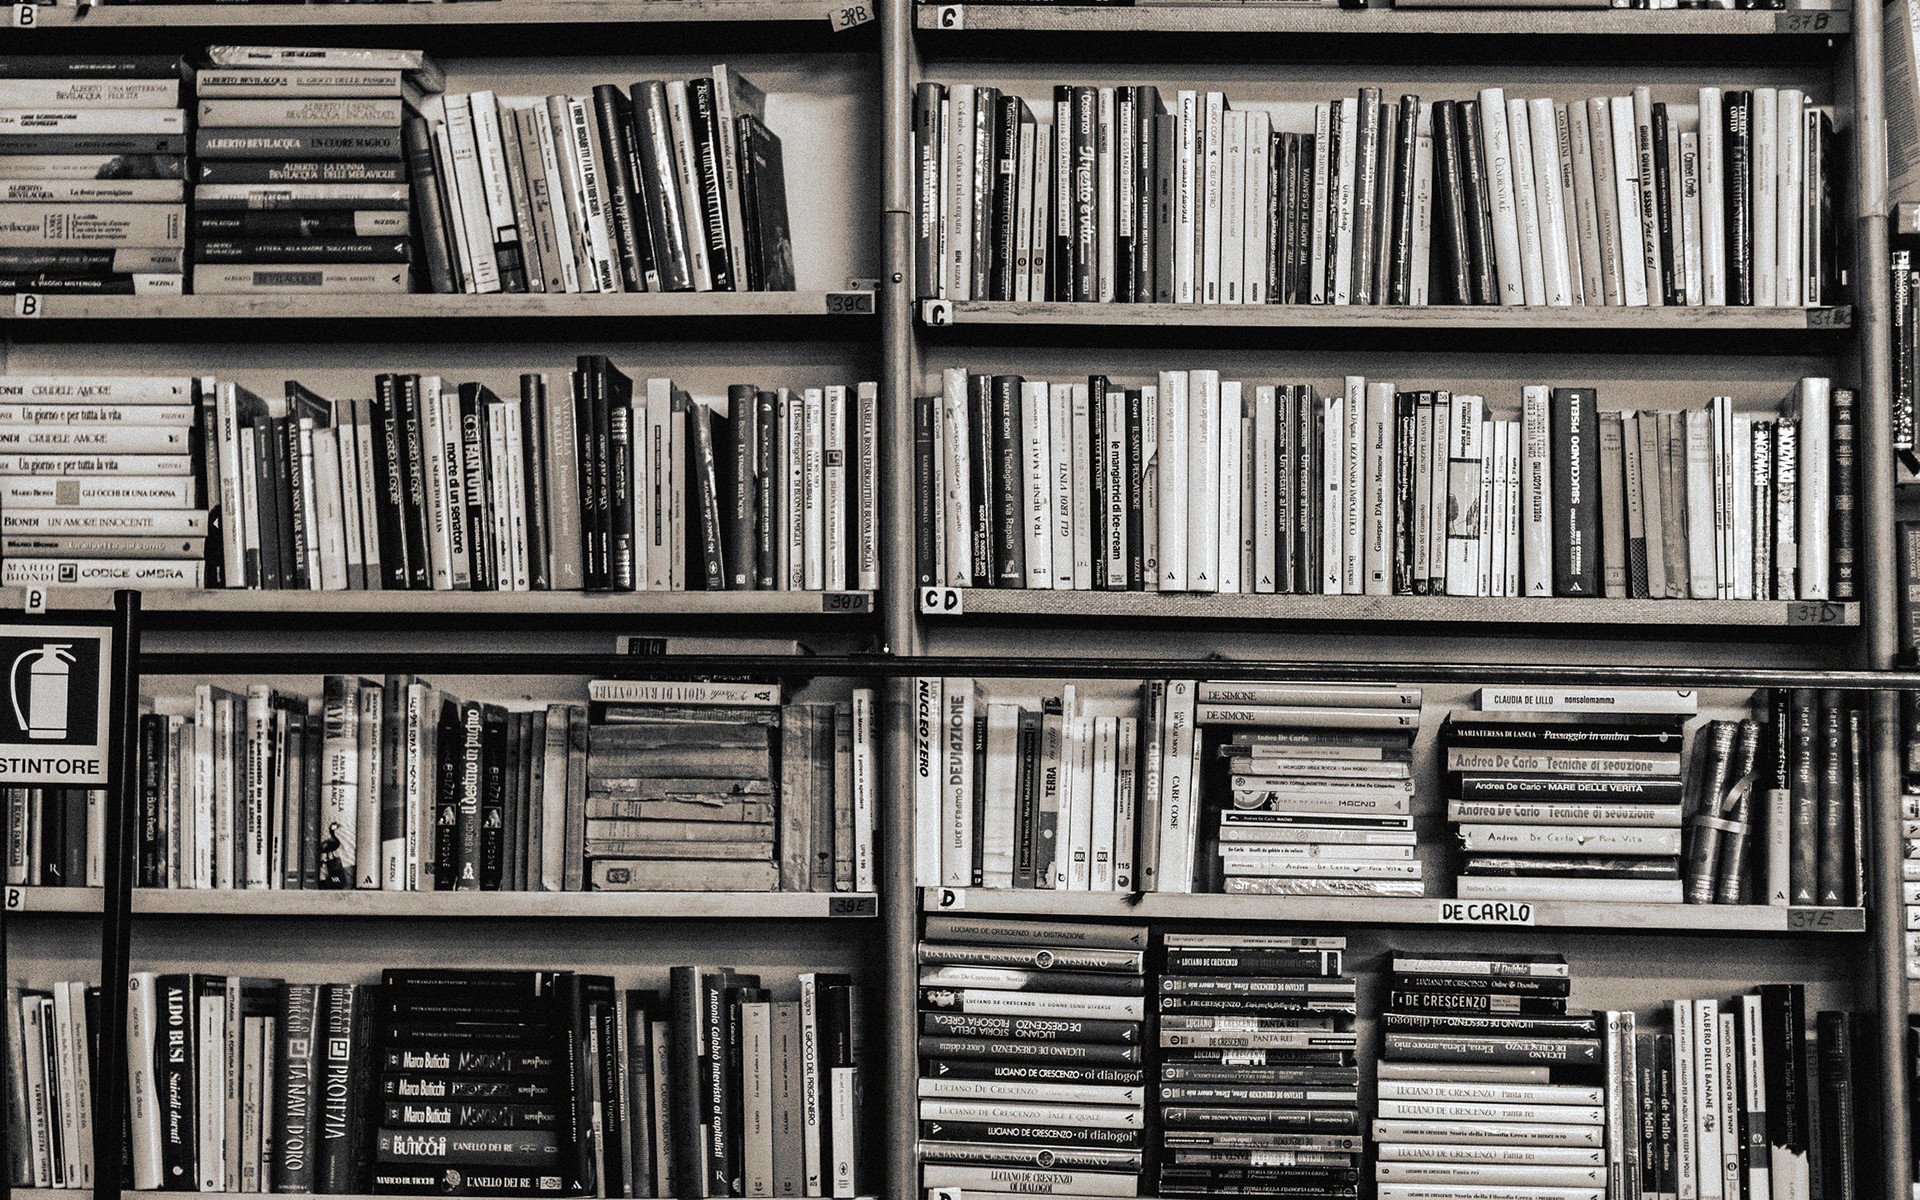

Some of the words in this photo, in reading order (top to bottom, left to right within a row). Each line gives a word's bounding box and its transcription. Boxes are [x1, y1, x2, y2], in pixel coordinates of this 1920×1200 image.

[20, 8, 34, 26] B
[956, 101, 966, 135] Colombo
[1730, 106, 1738, 132] COVITO
[1738, 106, 1746, 136] CARMEN
[206, 140, 245, 148] ALBERTO
[248, 140, 300, 150] BEVILACQUA
[1558, 110, 1568, 158] COSTANTINI
[1563, 163, 1571, 188] Veleno
[956, 144, 966, 182] Confucio
[1684, 152, 1696, 177] Carmen
[324, 171, 346, 179] DELLE
[348, 171, 396, 179] MERAVIGLIE
[956, 184, 965, 196] nel
[1302, 168, 1310, 209] CASANOVA
[1685, 178, 1696, 198] Covito
[954, 197, 964, 235] computer
[1302, 212, 1308, 220] DI
[599, 259, 613, 290] BOMPIANI
[22, 296, 36, 314] B
[932, 305, 945, 325] C
[1002, 382, 1010, 416] RAFFAELE
[22, 408, 33, 420] Un
[35, 411, 58, 424] giorno
[67, 412, 80, 424] per
[81, 409, 98, 420] tutta
[100, 409, 107, 420] la
[108, 409, 121, 420] vita
[1571, 394, 1579, 433] PISELLI
[1003, 418, 1011, 440] CROVI
[1111, 441, 1121, 450] le
[446, 443, 457, 476] morte
[1002, 448, 1013, 491] L'indagine
[1571, 436, 1580, 504] SBUCCIANDO
[449, 479, 459, 488] di
[1060, 462, 1068, 490] VINTI
[1110, 452, 1121, 500] mangiatrici
[450, 490, 459, 503] un
[1060, 495, 1068, 516] EROI
[1112, 502, 1121, 513] di
[1005, 504, 1013, 515] via
[450, 506, 463, 554] senatore
[1003, 518, 1014, 550] Rapallo
[1061, 520, 1069, 537] GLI
[1112, 514, 1121, 560] ice-cream
[82, 569, 129, 578] CODICE
[136, 569, 183, 578] OMBRA
[30, 590, 41, 608] B
[830, 595, 863, 609] 38D
[594, 686, 658, 700] RACCONTARE
[661, 687, 673, 700] DI
[677, 687, 706, 700] GIOIA
[1208, 691, 1222, 699] DE
[1223, 692, 1257, 701] SIMONE
[1494, 695, 1523, 704] CLAUDIA
[1524, 696, 1533, 705] DE
[1536, 696, 1553, 705] LILLO
[1564, 696, 1615, 704] nonsolomamma
[919, 680, 929, 737] NUCLEO
[1206, 711, 1221, 720] DE
[1221, 712, 1255, 721] SIMONE
[464, 709, 482, 747] pugno
[1830, 737, 1837, 748] De
[464, 749, 478, 760] in
[919, 740, 929, 777] ZERO
[1148, 741, 1159, 771] CARE
[1828, 752, 1837, 784] Filippi
[461, 762, 478, 804] destino
[1045, 767, 1056, 797] TERRA
[1147, 772, 1158, 801] COSE
[1171, 776, 1180, 802] CARE
[1548, 783, 1576, 791] MARE
[1610, 784, 1643, 792] VERITÀ
[461, 805, 476, 814] il
[1170, 805, 1179, 830] COSE
[1829, 800, 1838, 826] Amici
[1118, 862, 1130, 870] 115
[6, 890, 21, 908] B
[940, 890, 956, 907] D
[1443, 904, 1463, 920] DE
[1468, 904, 1530, 922] CARLO
[950, 926, 979, 934] LUCIANO
[991, 928, 1030, 936] CRESCENZO
[1033, 930, 1044, 938] LA
[1046, 931, 1085, 940] DISTRAZIONE
[168, 987, 183, 1026] ALDO
[710, 989, 720, 1024] Antonio
[1406, 995, 1420, 1005] DE
[1423, 996, 1487, 1008] CRESCENZO
[1703, 1006, 1712, 1046] L'ALBERO
[169, 1030, 184, 1063] BUSI
[711, 1026, 722, 1060] Calabrò
[403, 1052, 423, 1068] Marco
[424, 1051, 450, 1068] Buticchi
[1704, 1048, 1712, 1071] DELLE
[712, 1062, 722, 1103] Intervista
[995, 1067, 1028, 1077] LUCIANO
[1028, 1069, 1038, 1077] DE
[1038, 1069, 1080, 1078] CRESCENZO
[1084, 1070, 1093, 1079] oi
[1095, 1070, 1140, 1083] dialogoi
[169, 1072, 180, 1108] Suicidi
[1396, 1087, 1433, 1096] LUCIANO
[1436, 1088, 1447, 1096] DE
[1448, 1089, 1495, 1098] CRESCENZO
[1501, 1091, 1523, 1099] Panta
[1705, 1073, 1713, 1109] BANANE
[713, 1105, 721, 1114] ai
[1662, 1098, 1669, 1111] de
[170, 1110, 182, 1144] dovuti
[712, 1116, 724, 1158] capitalisti
[1662, 1112, 1670, 1140] Mello
[467, 1176, 502, 1187] L'ANELLO
[504, 1177, 518, 1187] DEI
[520, 1178, 530, 1187] RE
